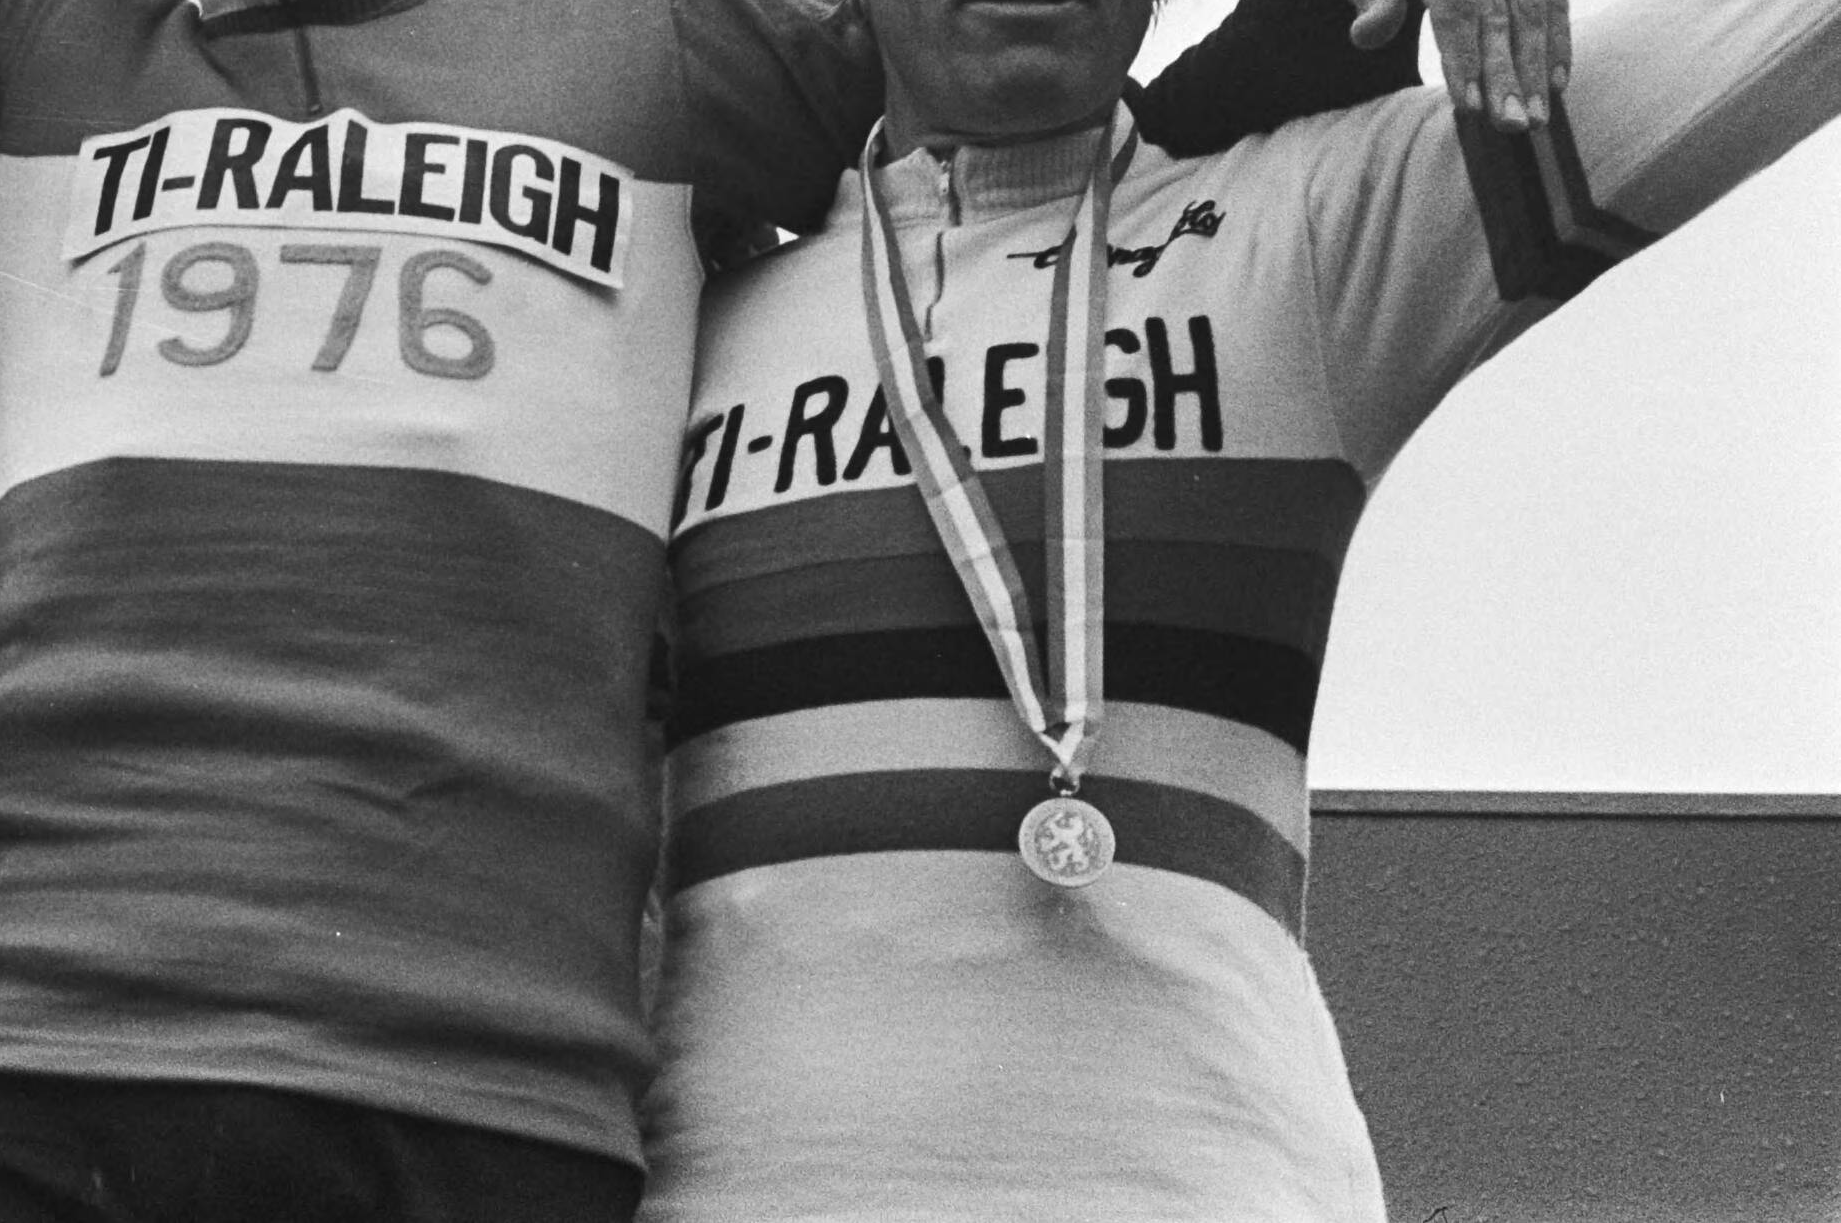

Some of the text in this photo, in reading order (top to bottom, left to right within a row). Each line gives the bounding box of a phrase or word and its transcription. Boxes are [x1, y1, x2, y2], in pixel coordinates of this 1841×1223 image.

[91, 117, 620, 274] TI-RALEIGH
[96, 240, 497, 380] 1976
[668, 314, 1224, 535] TI-RAEGH
